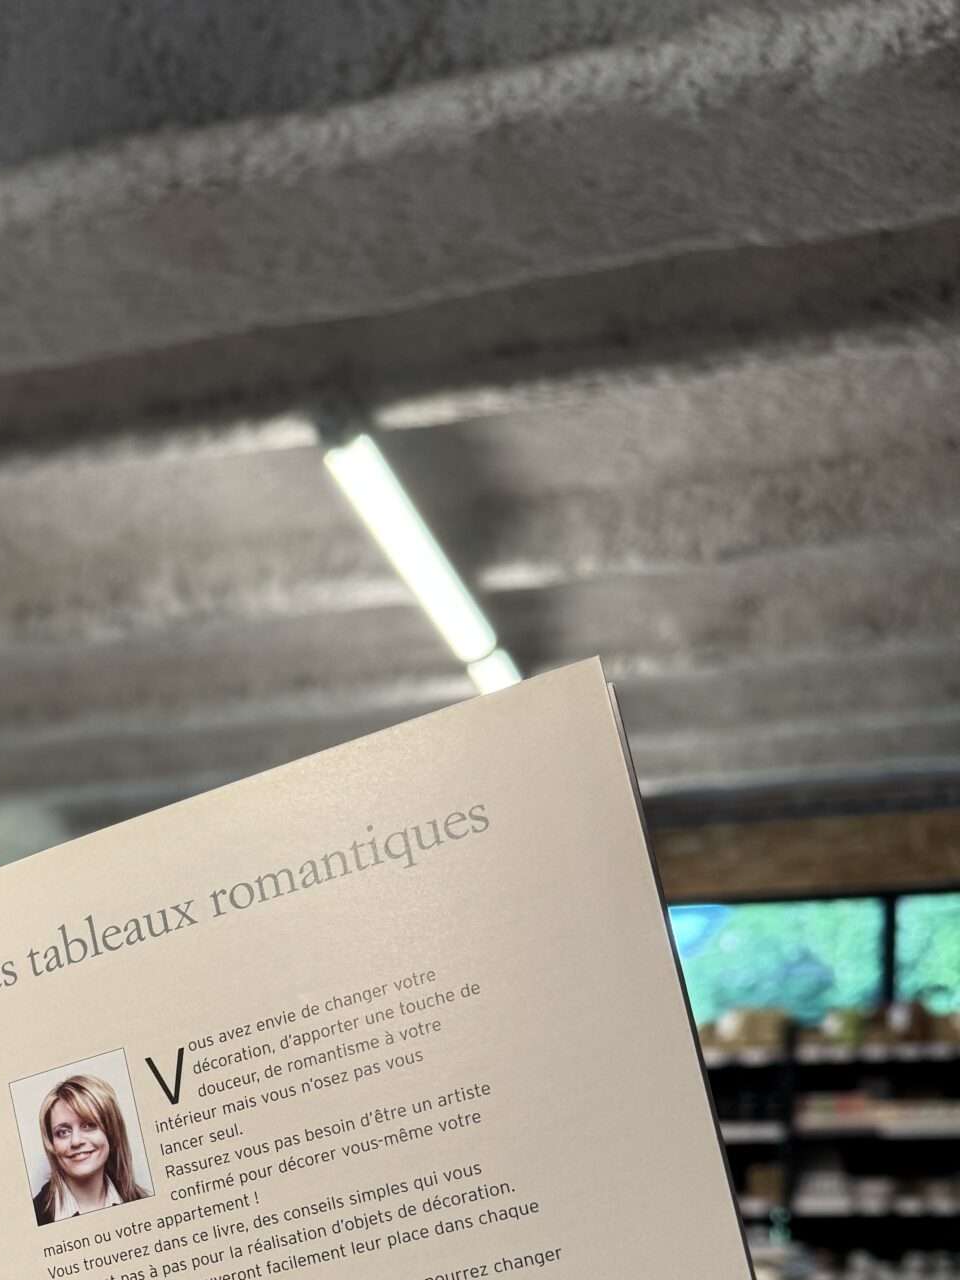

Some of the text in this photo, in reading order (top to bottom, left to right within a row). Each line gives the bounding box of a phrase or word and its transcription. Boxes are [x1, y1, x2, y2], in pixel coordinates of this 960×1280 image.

[27, 899, 199, 977] tableaux
[209, 805, 490, 918] romantiques
[193, 983, 481, 1075] décoration, d'apporter une touche de
[219, 1024, 253, 1043] avez
[256, 1010, 297, 1032] envie
[301, 1004, 320, 1019] de
[325, 984, 388, 1012] changer
[393, 971, 436, 992] votre
[155, 1051, 424, 1134] intérieur mais vous n'osez pas vous
[198, 1021, 441, 1098] douceur, de romantisme à votre
[160, 1123, 244, 1157] lancer seul.
[165, 1084, 491, 1179] Rassurez vous pas besoin d'être un artiste
[170, 1113, 481, 1201] confirmé pour décorer vous-même votre
[43, 1237, 91, 1258] maison
[94, 1232, 112, 1245] ou
[115, 1221, 153, 1239] votre
[157, 1194, 251, 1230] appartement
